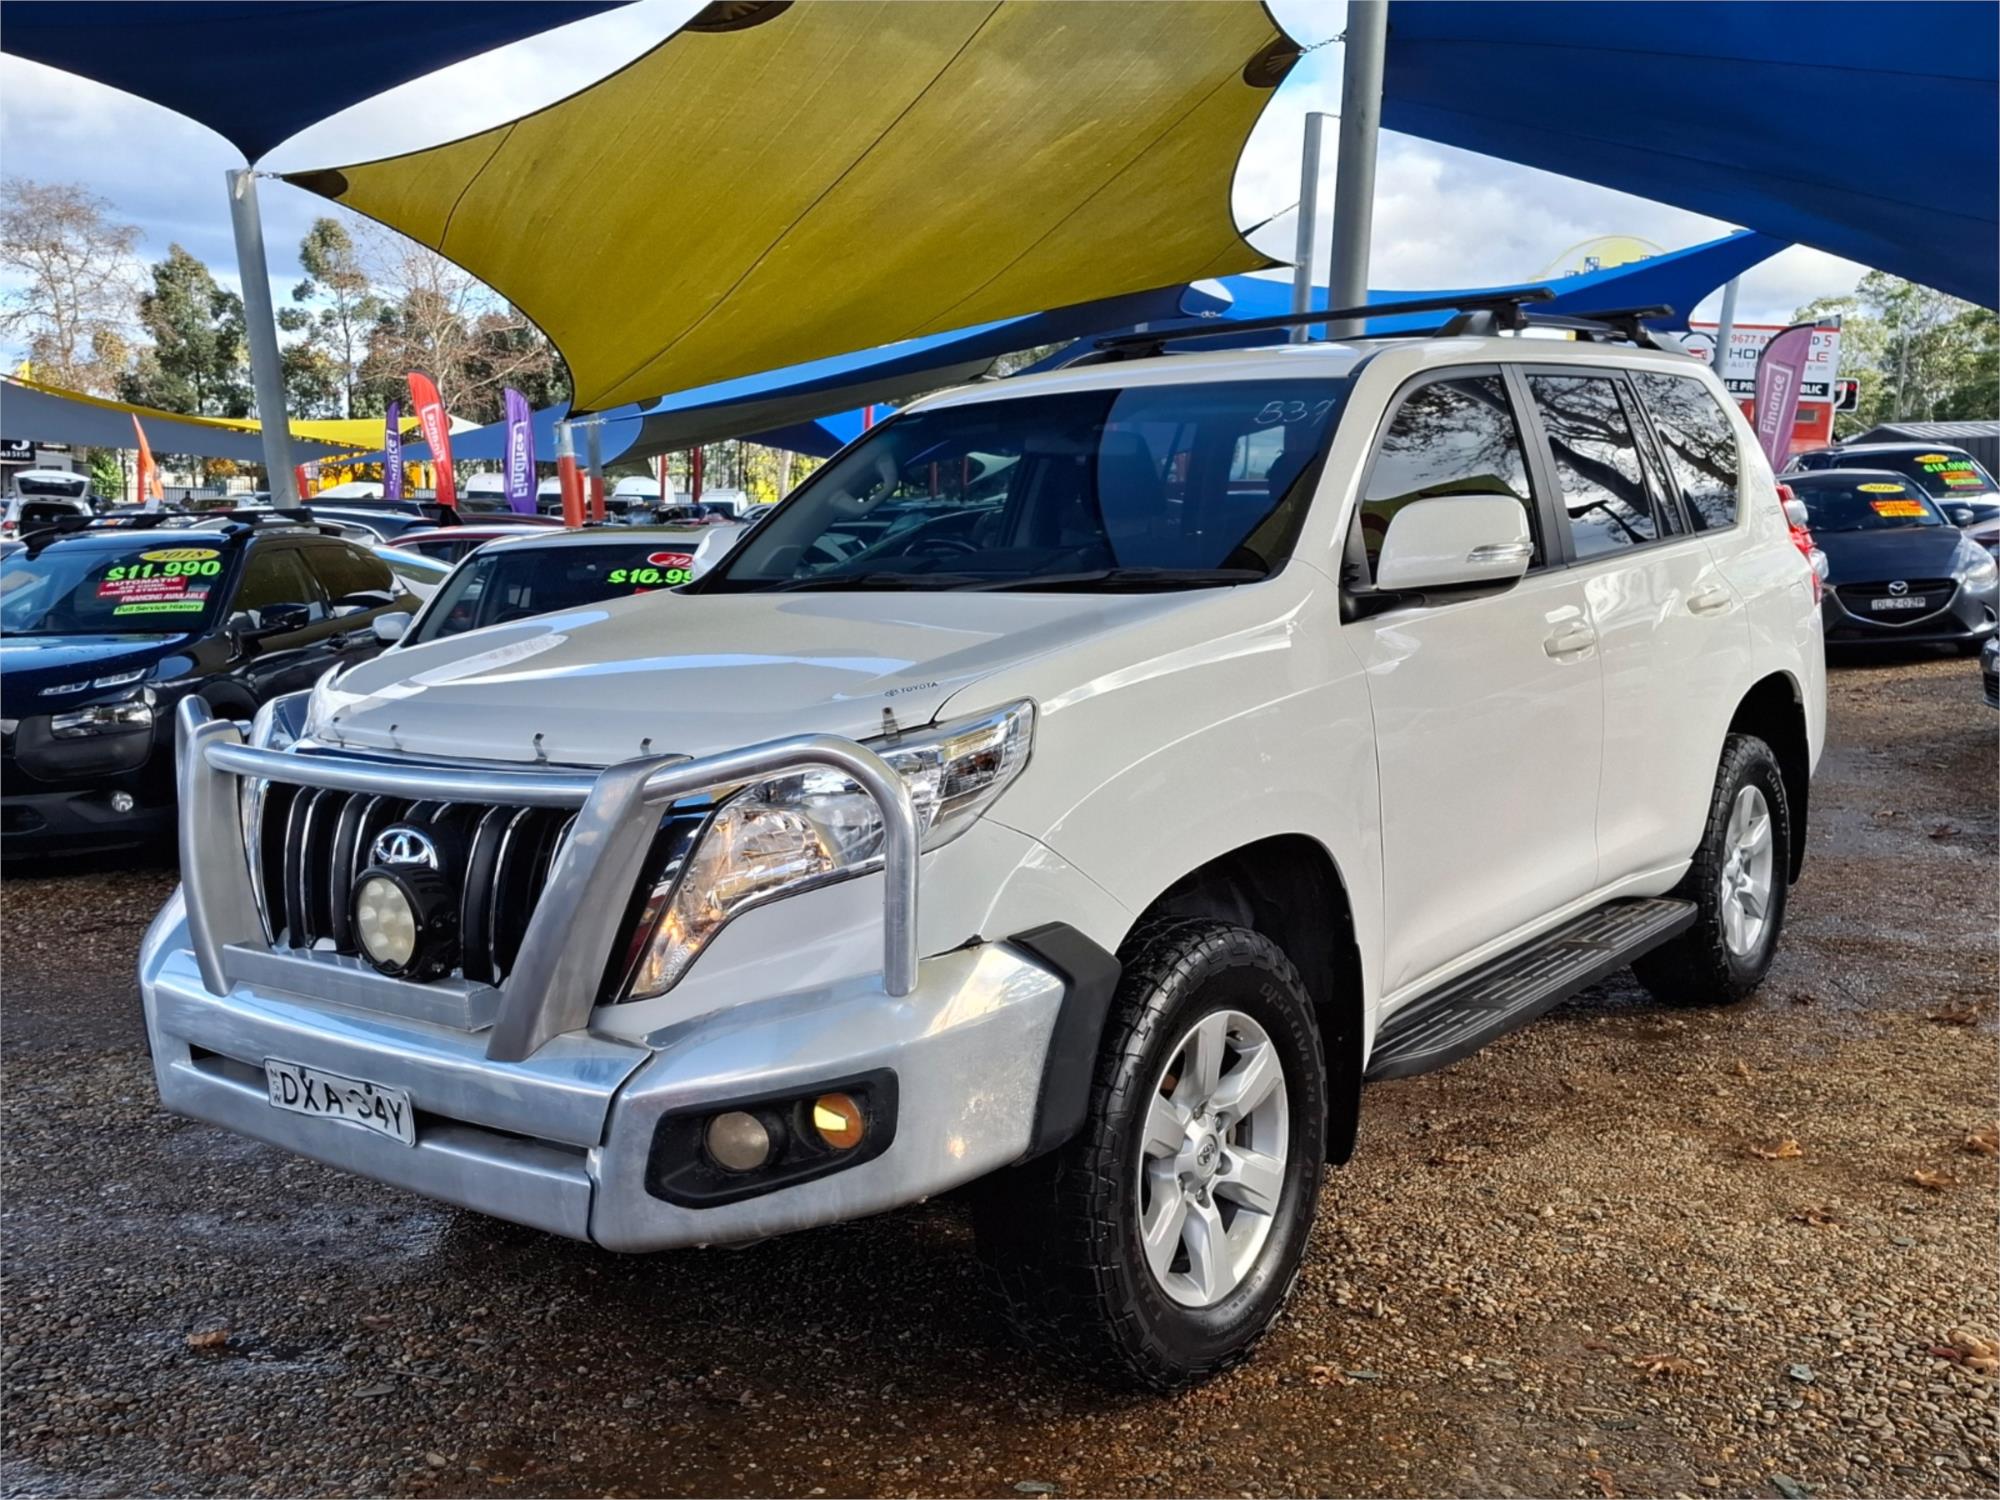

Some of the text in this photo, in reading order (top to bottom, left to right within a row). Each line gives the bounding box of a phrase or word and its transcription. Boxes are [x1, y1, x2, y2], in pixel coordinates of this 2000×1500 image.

[1731, 334, 1757, 344] 9677
[1762, 374, 1786, 435] Finance
[105, 560, 221, 581] $11.990
[105, 576, 181, 588] AUTOMATIC
[120, 591, 207, 602] FINANCING AVAILABLE
[135, 603, 168, 612] Service
[169, 602, 201, 612] History
[901, 681, 938, 693] TOYOTA
